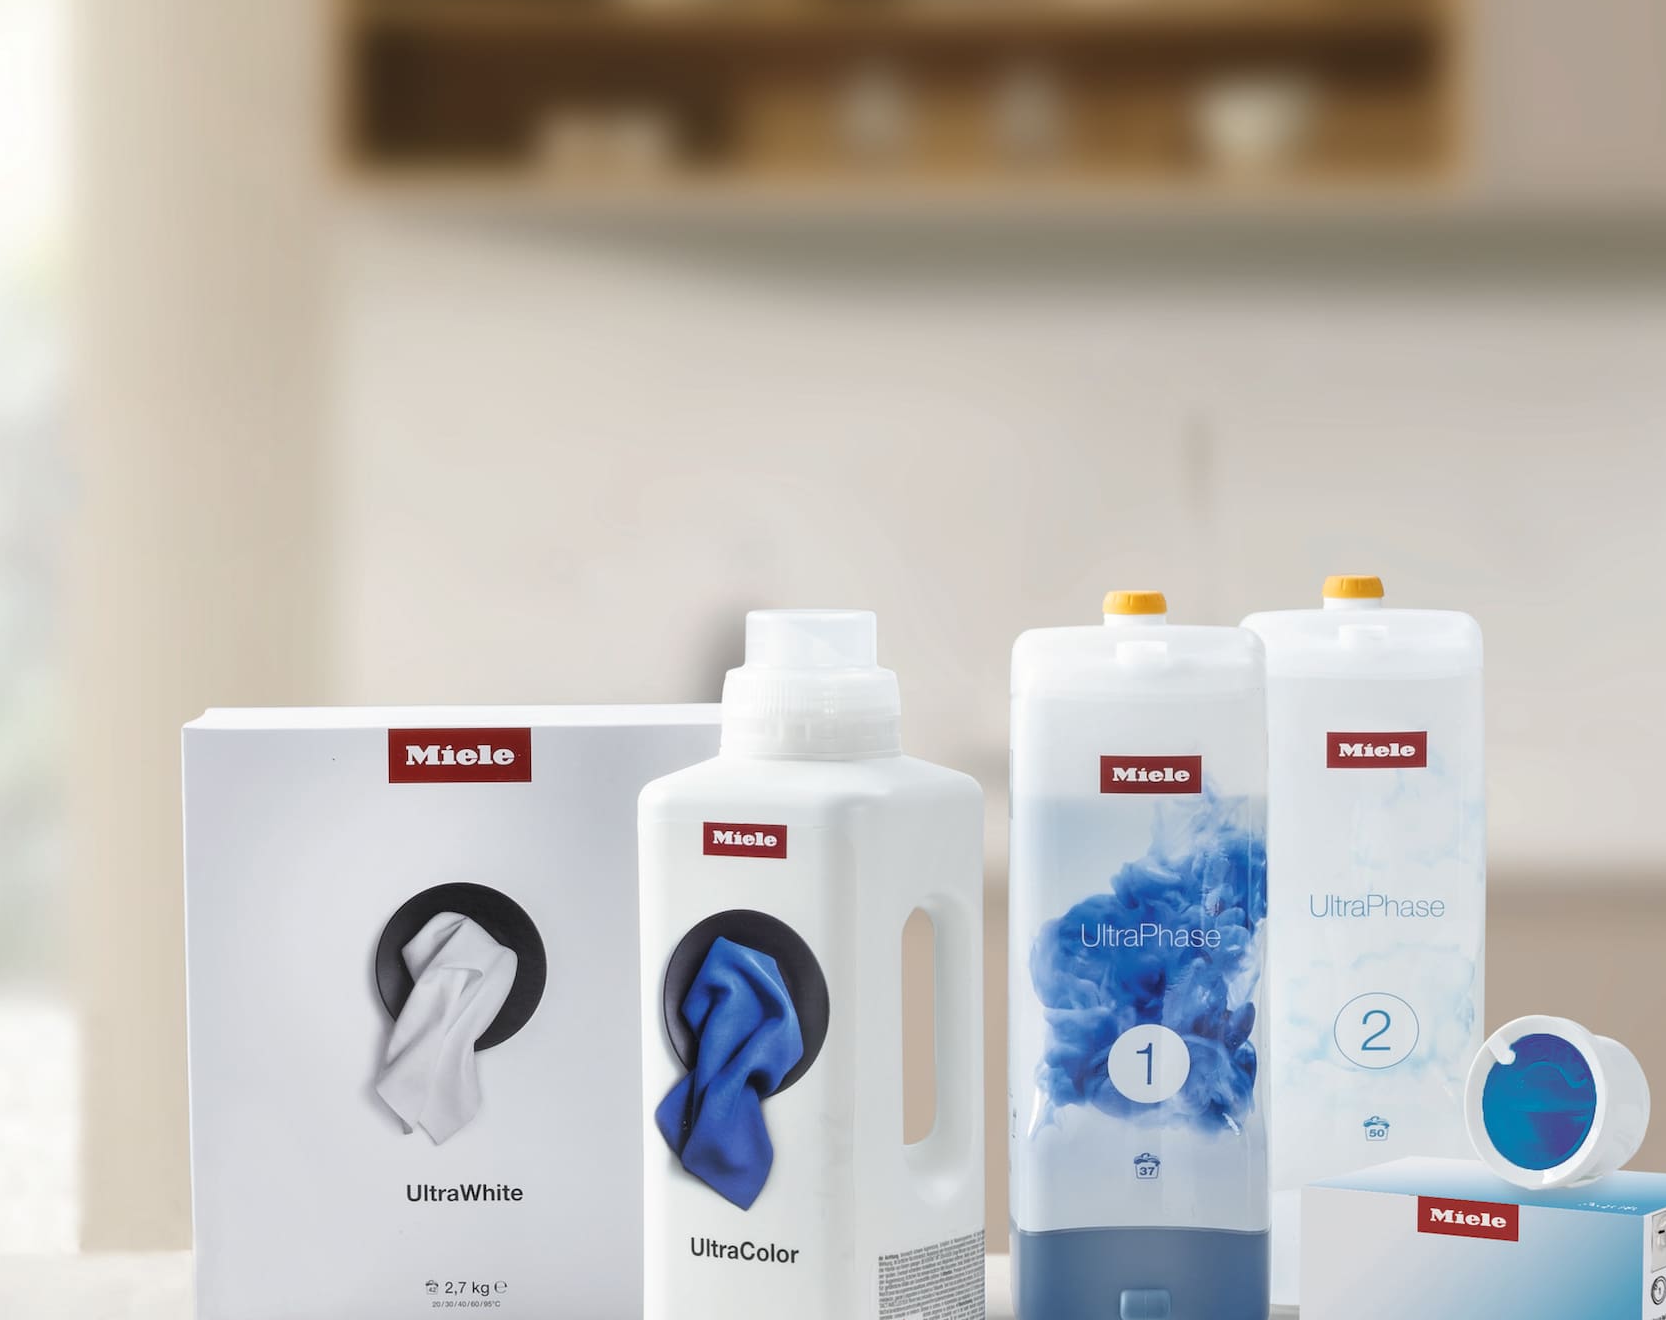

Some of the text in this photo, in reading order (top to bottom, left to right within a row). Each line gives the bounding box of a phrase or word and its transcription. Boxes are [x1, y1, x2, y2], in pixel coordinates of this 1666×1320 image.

[405, 745, 515, 766] Miele
[1338, 743, 1416, 757] Miele
[1112, 767, 1191, 783] Miele
[713, 830, 778, 847] Miele
[1310, 894, 1445, 918] UltraPhase
[1081, 923, 1221, 948] UltraPhase
[1361, 1009, 1391, 1051] 2
[1136, 1042, 1153, 1086] 1
[1369, 1128, 1385, 1138] 50
[1139, 1166, 1155, 1176] 37
[406, 1183, 524, 1202] UltraWhite
[1430, 1208, 1507, 1229] Miele
[691, 1236, 800, 1264] UltraColor
[445, 1281, 467, 1296] 2,7
[472, 1281, 490, 1297] kg
